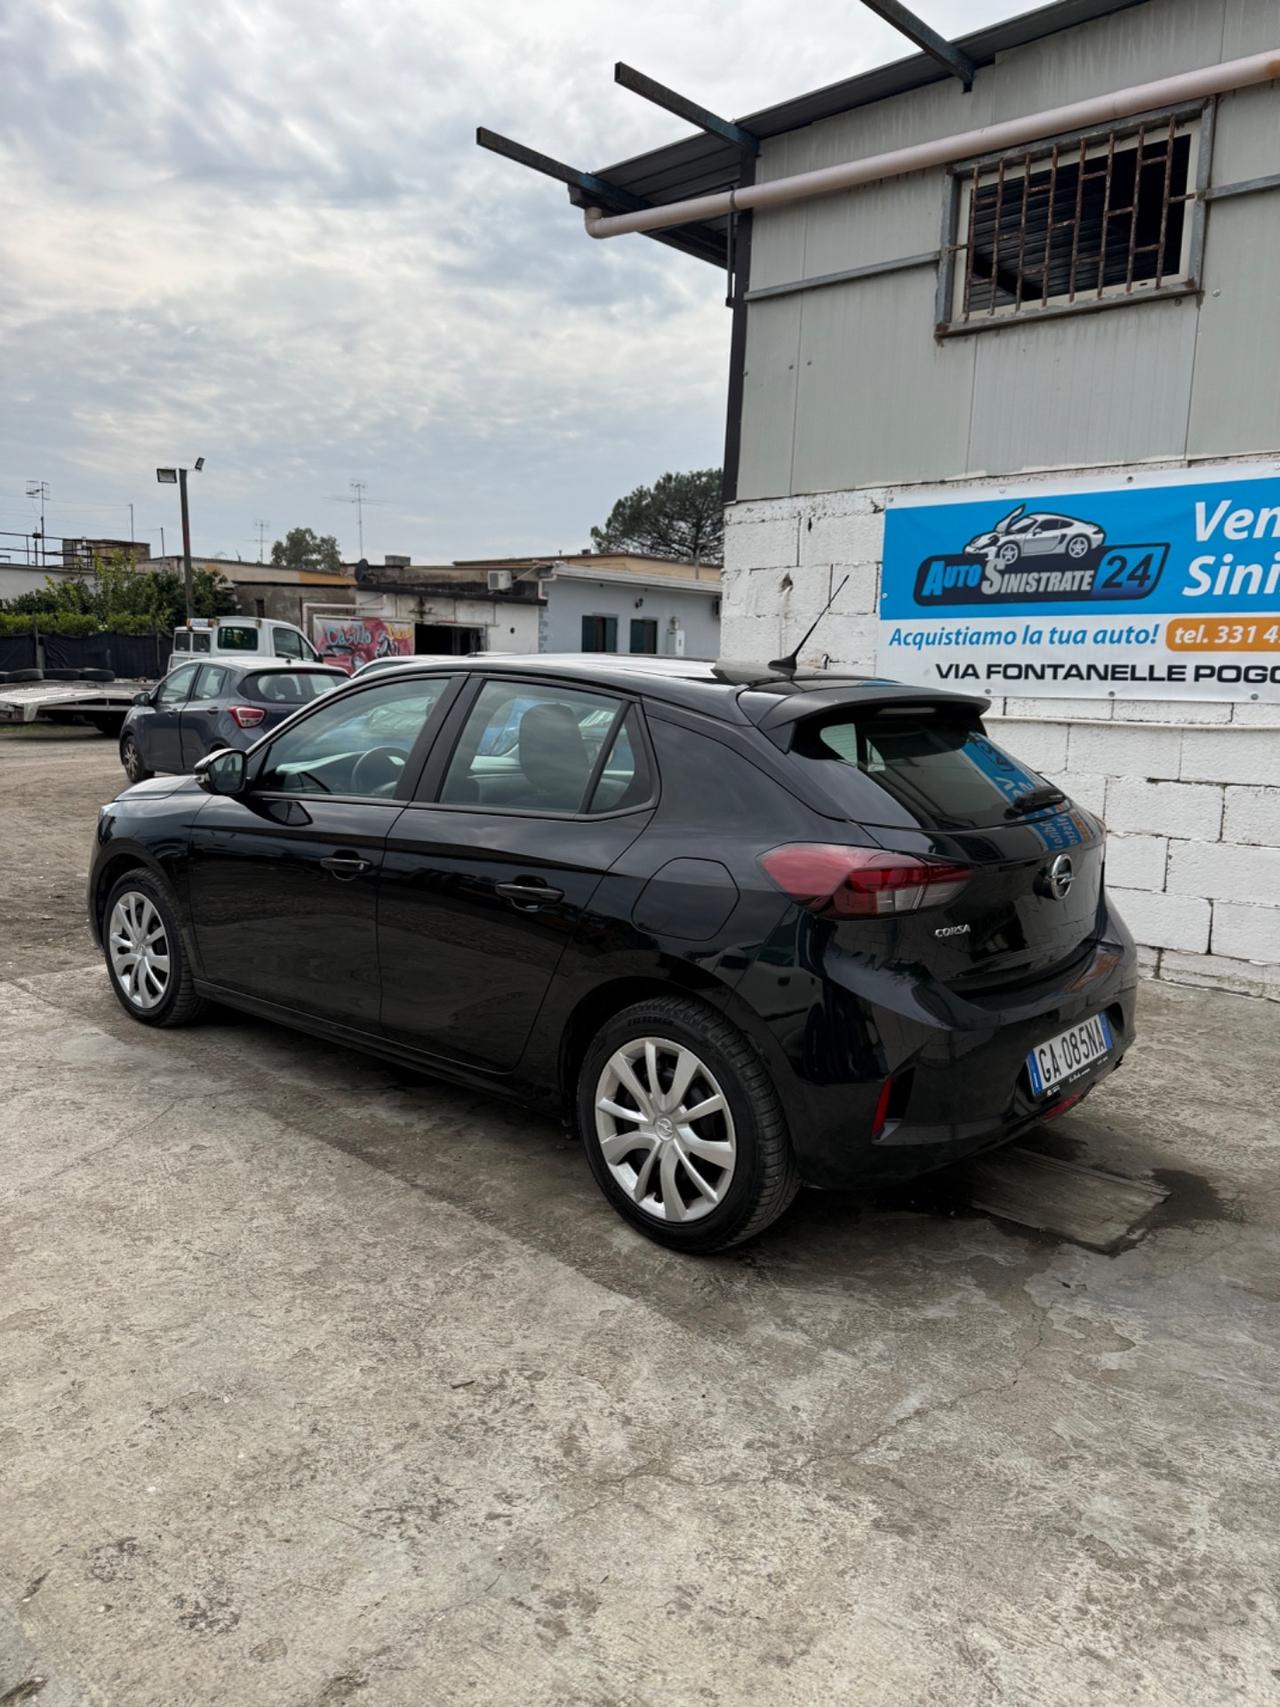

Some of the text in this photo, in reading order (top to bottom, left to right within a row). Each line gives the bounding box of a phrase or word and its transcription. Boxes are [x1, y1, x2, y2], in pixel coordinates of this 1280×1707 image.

[1101, 554, 1156, 590] 24
[888, 623, 1161, 651] Acquistiamo la tua auto!
[1174, 624, 1209, 644] tel.
[1214, 625, 1257, 645] 331
[935, 663, 981, 680] VIA
[986, 663, 1187, 683] FONTANELLE
[935, 924, 971, 937] CORSA
[1038, 1019, 1106, 1083] GA 085NA
